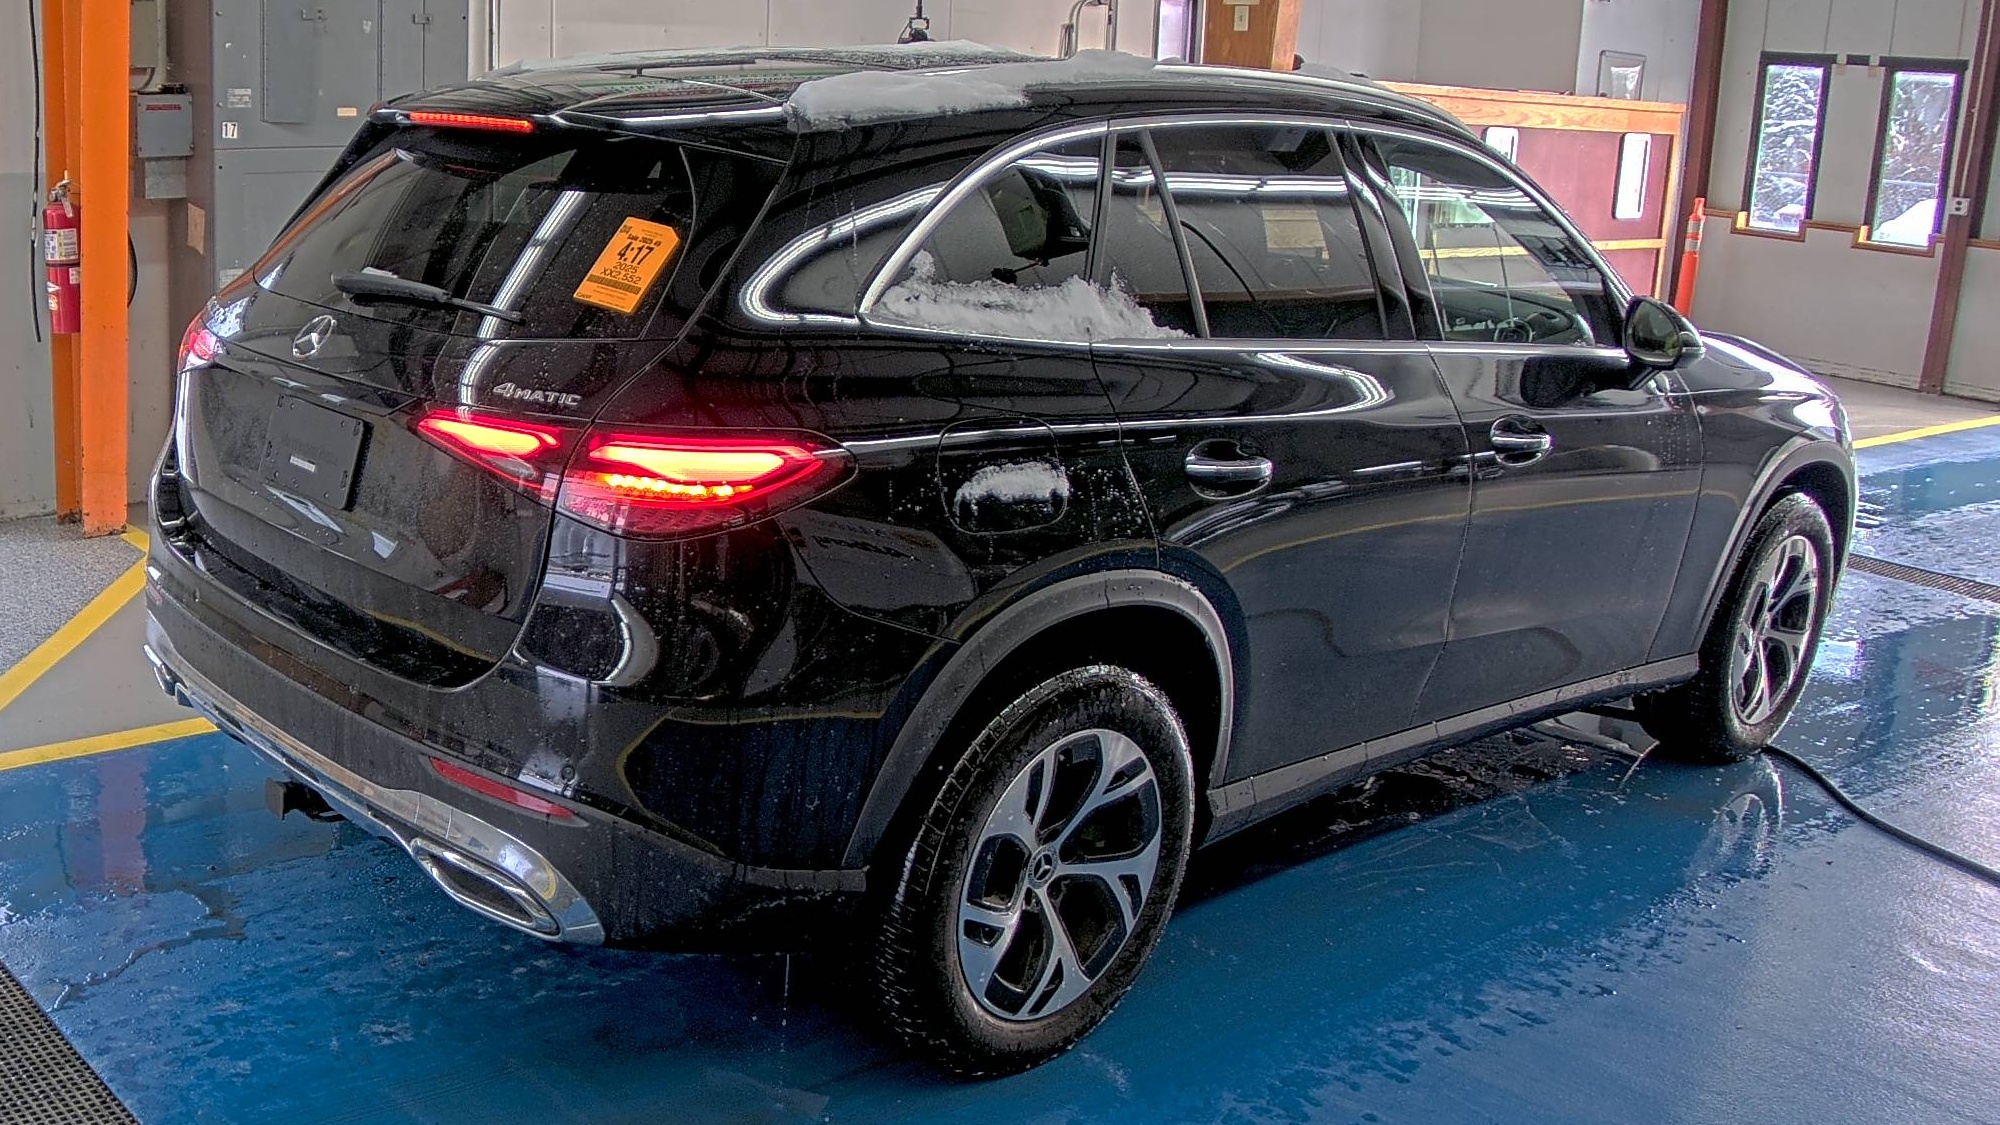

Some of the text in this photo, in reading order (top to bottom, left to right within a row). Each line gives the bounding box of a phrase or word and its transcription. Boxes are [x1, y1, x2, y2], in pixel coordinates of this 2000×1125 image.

[224, 123, 237, 138] 17
[612, 261, 640, 274] 2025
[493, 382, 582, 406] 4MATIC
